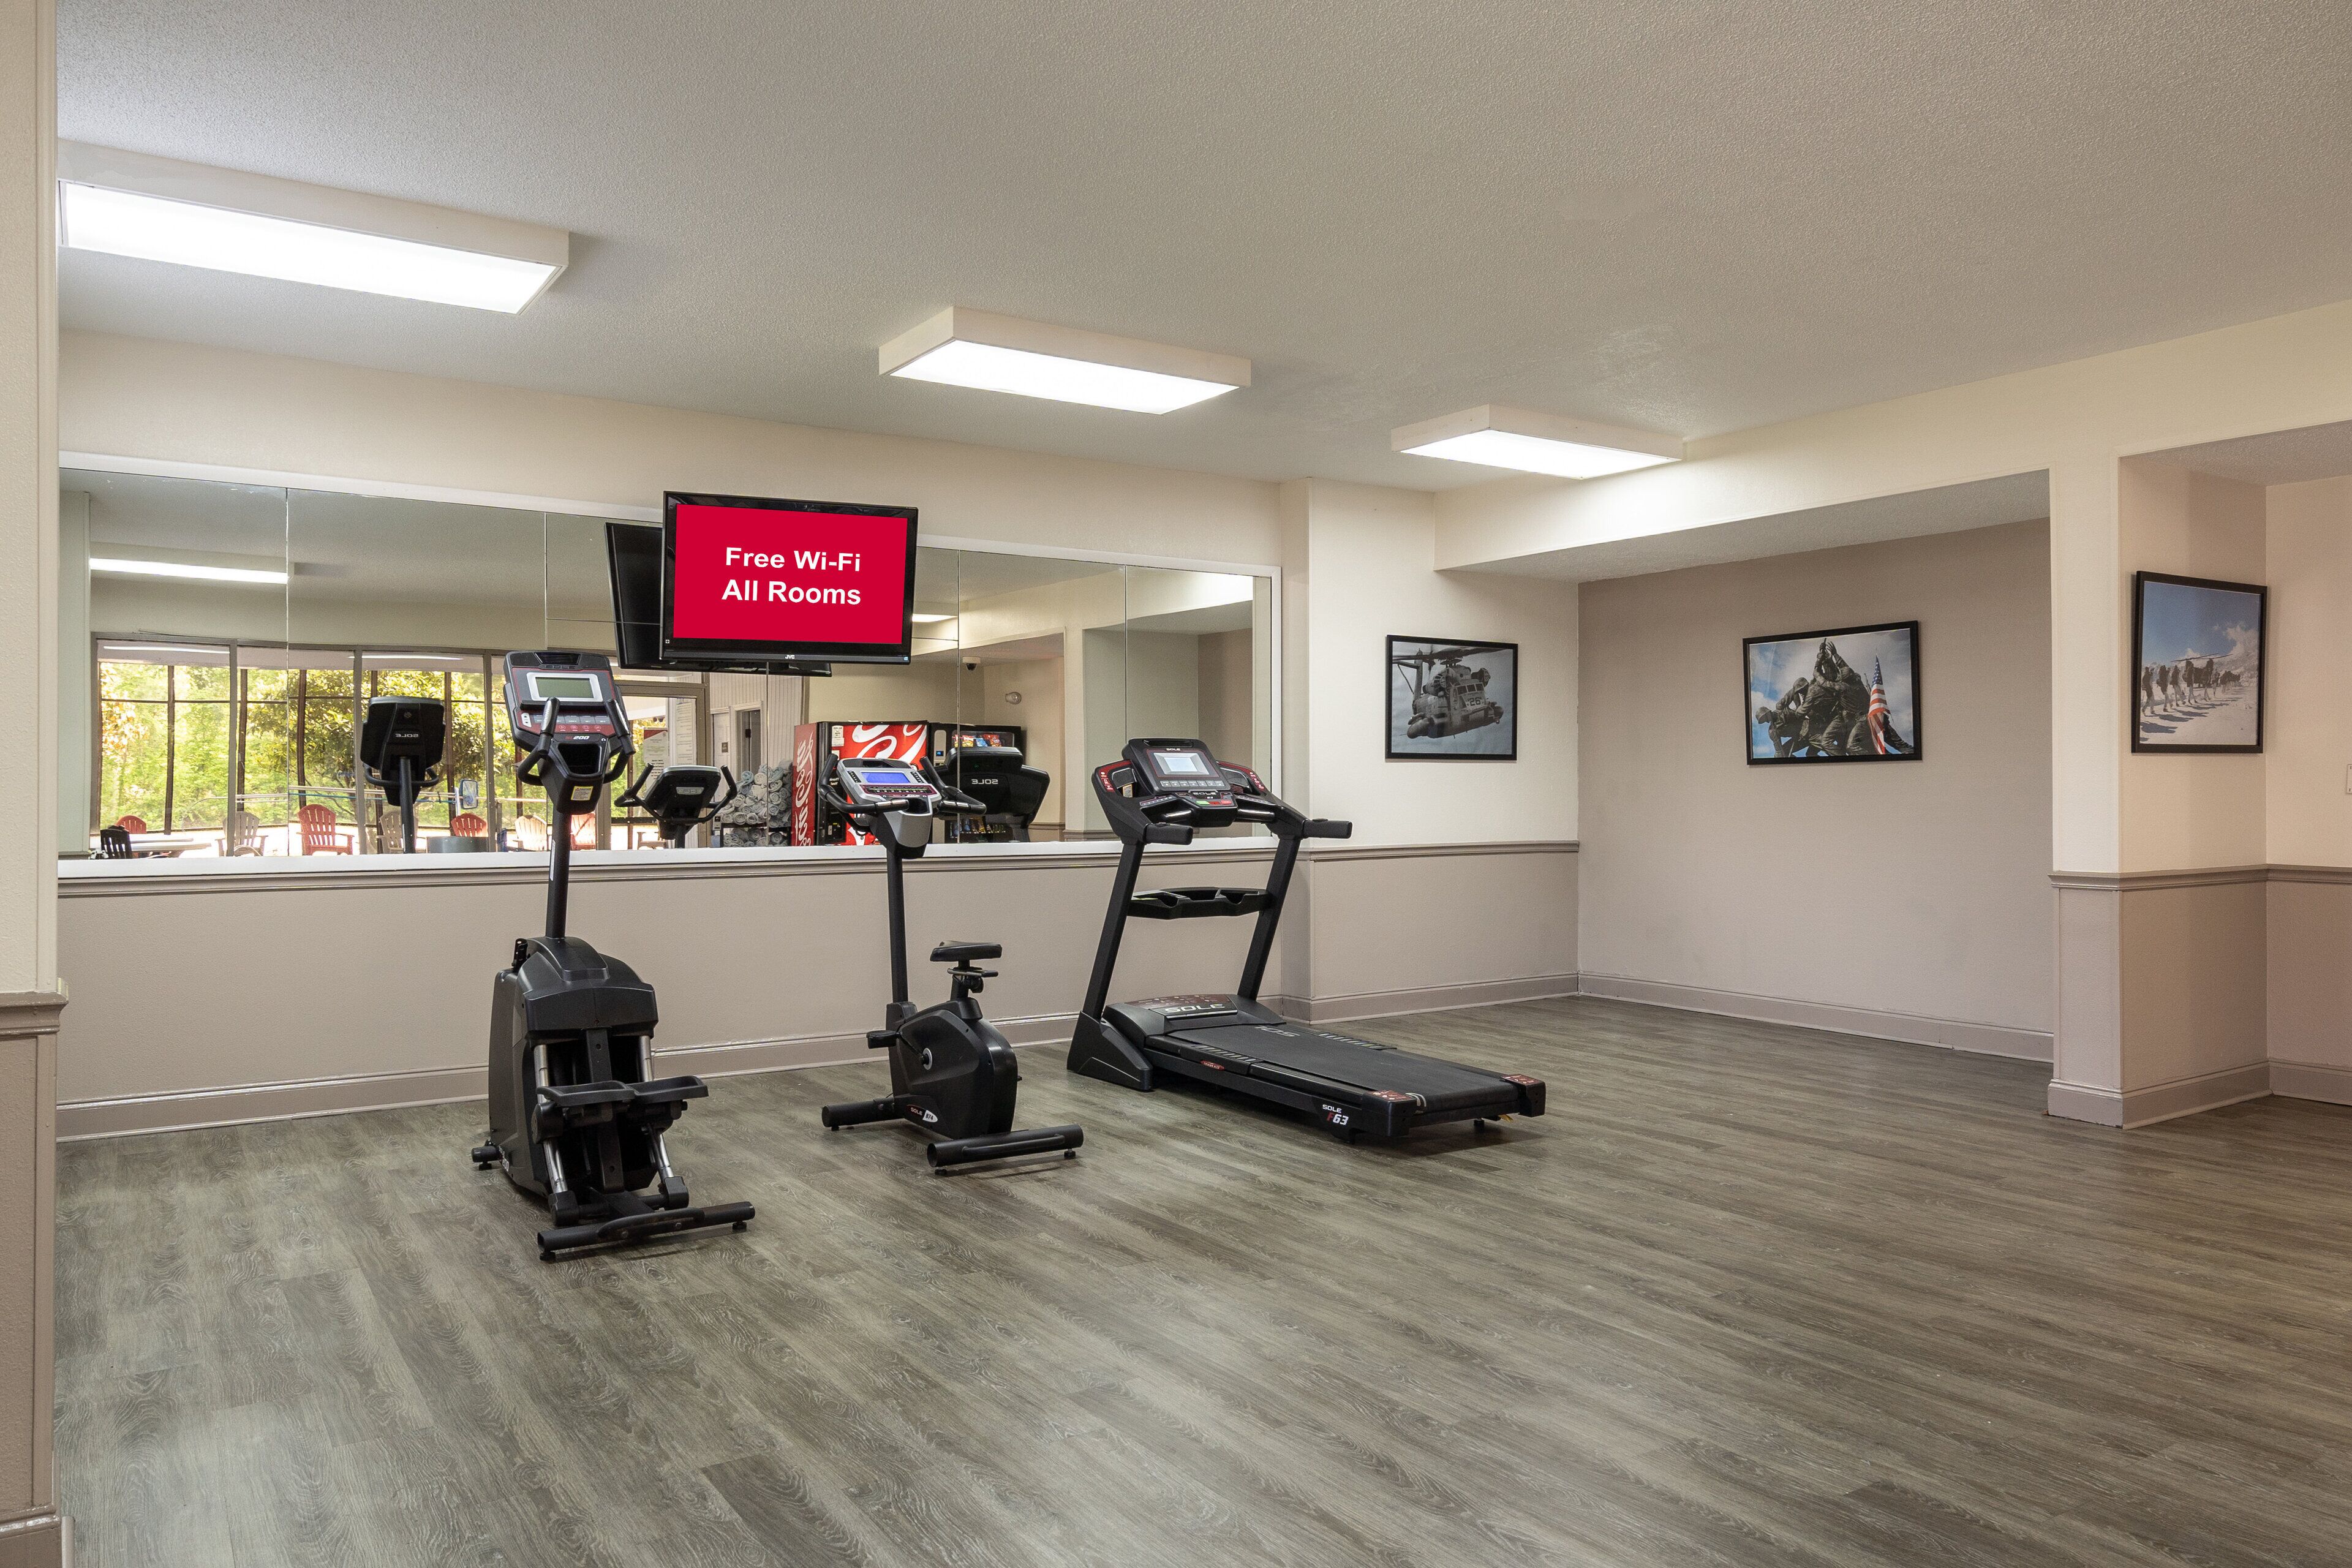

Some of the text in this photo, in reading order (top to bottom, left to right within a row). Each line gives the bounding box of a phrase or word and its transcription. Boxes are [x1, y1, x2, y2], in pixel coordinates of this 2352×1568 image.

[726, 547, 861, 571] Free Wi-Fi
[722, 579, 861, 605] All Rooms
[1164, 1003, 1226, 1014] SOLE
[1254, 1025, 1301, 1037] SOL
[910, 1107, 923, 1116] SOLE
[1322, 1104, 1342, 1114] SOLE
[1326, 1112, 1349, 1125] F63
